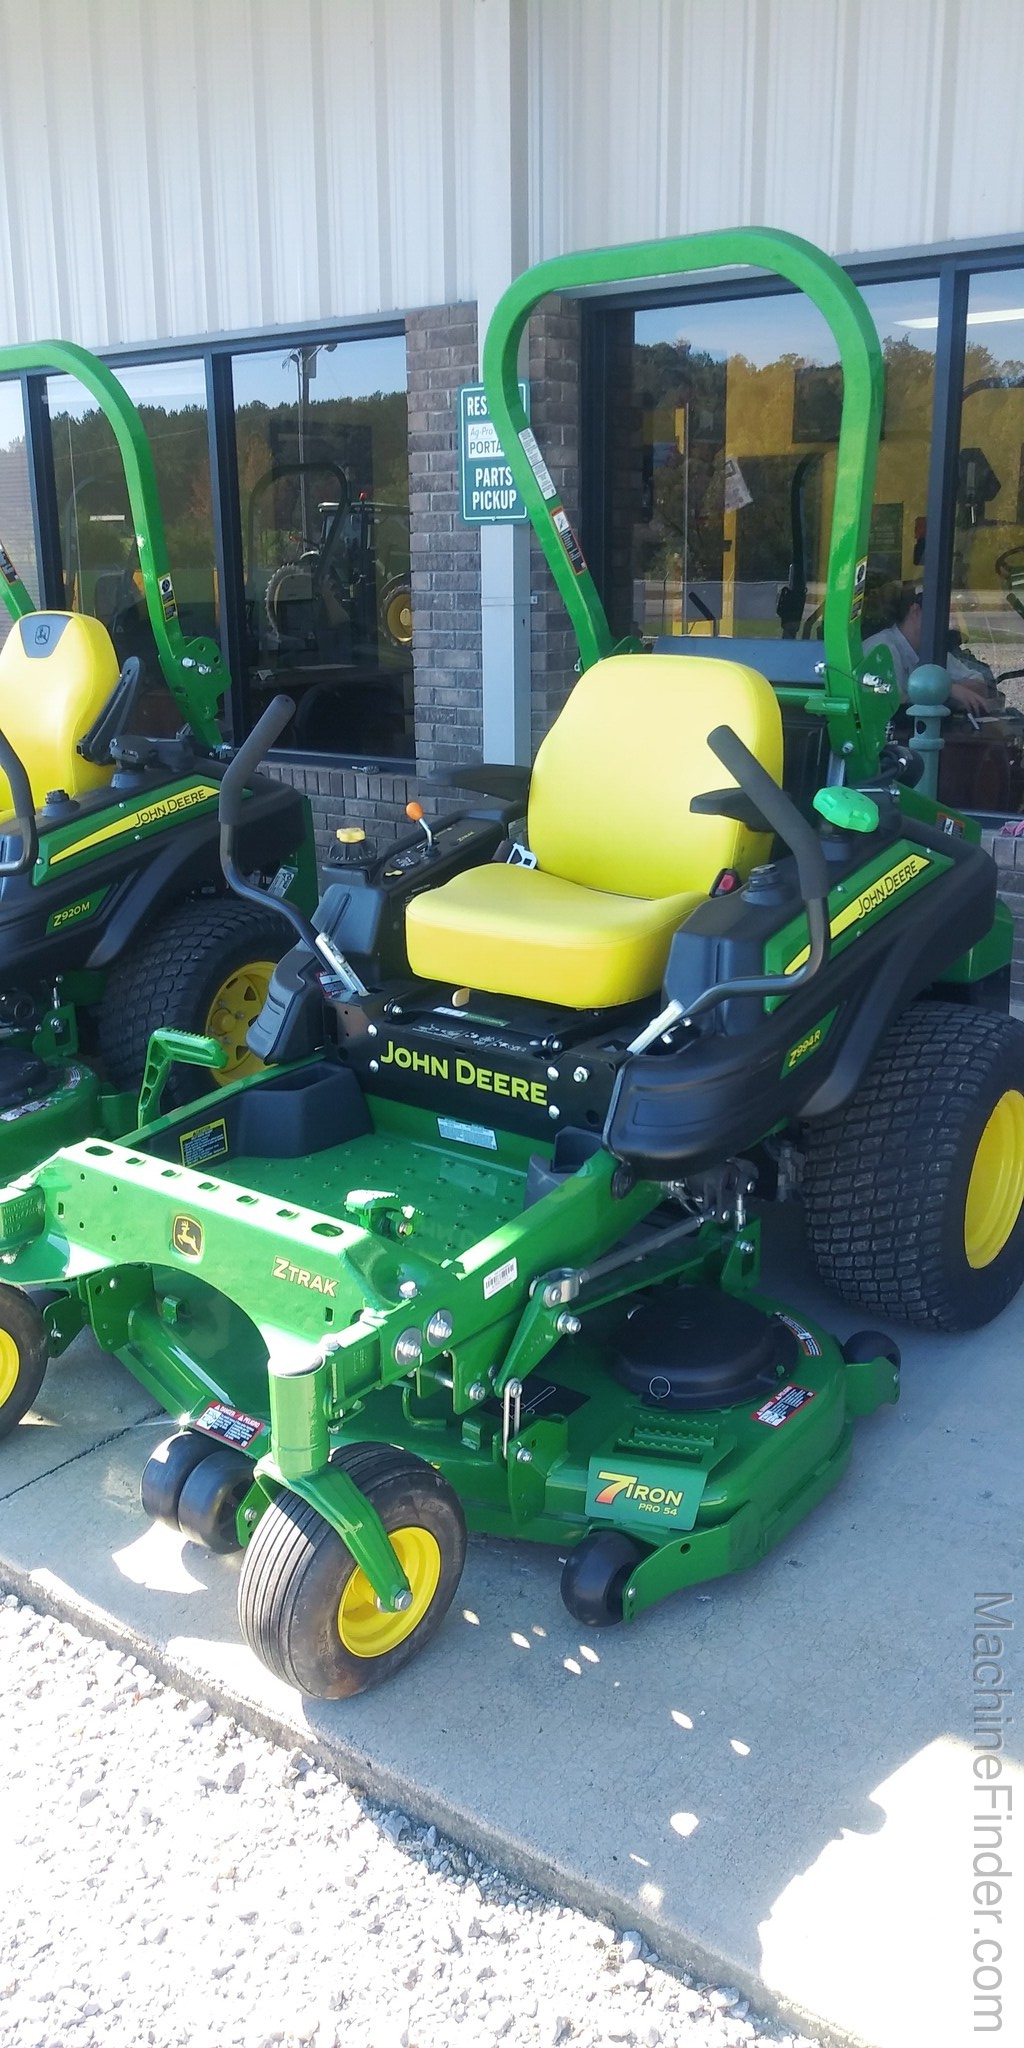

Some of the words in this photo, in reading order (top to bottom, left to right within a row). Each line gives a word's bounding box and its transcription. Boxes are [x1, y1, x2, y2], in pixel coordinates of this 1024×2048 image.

[467, 396, 490, 416] RES
[476, 466, 513, 487] PARTS
[472, 490, 517, 510] PICKUP
[135, 805, 167, 826] JOHN
[167, 789, 207, 813] DEERE
[857, 887, 884, 916] JOHN
[884, 861, 918, 892] DEERE
[53, 901, 90, 927] Z920M
[789, 1029, 821, 1067] Z994R
[380, 1040, 449, 1080] JOHN
[456, 1058, 548, 1106] DEERE
[273, 1256, 339, 1298] ZTRAK
[638, 1503, 660, 1513] PRO
[663, 1507, 678, 1516] 54
